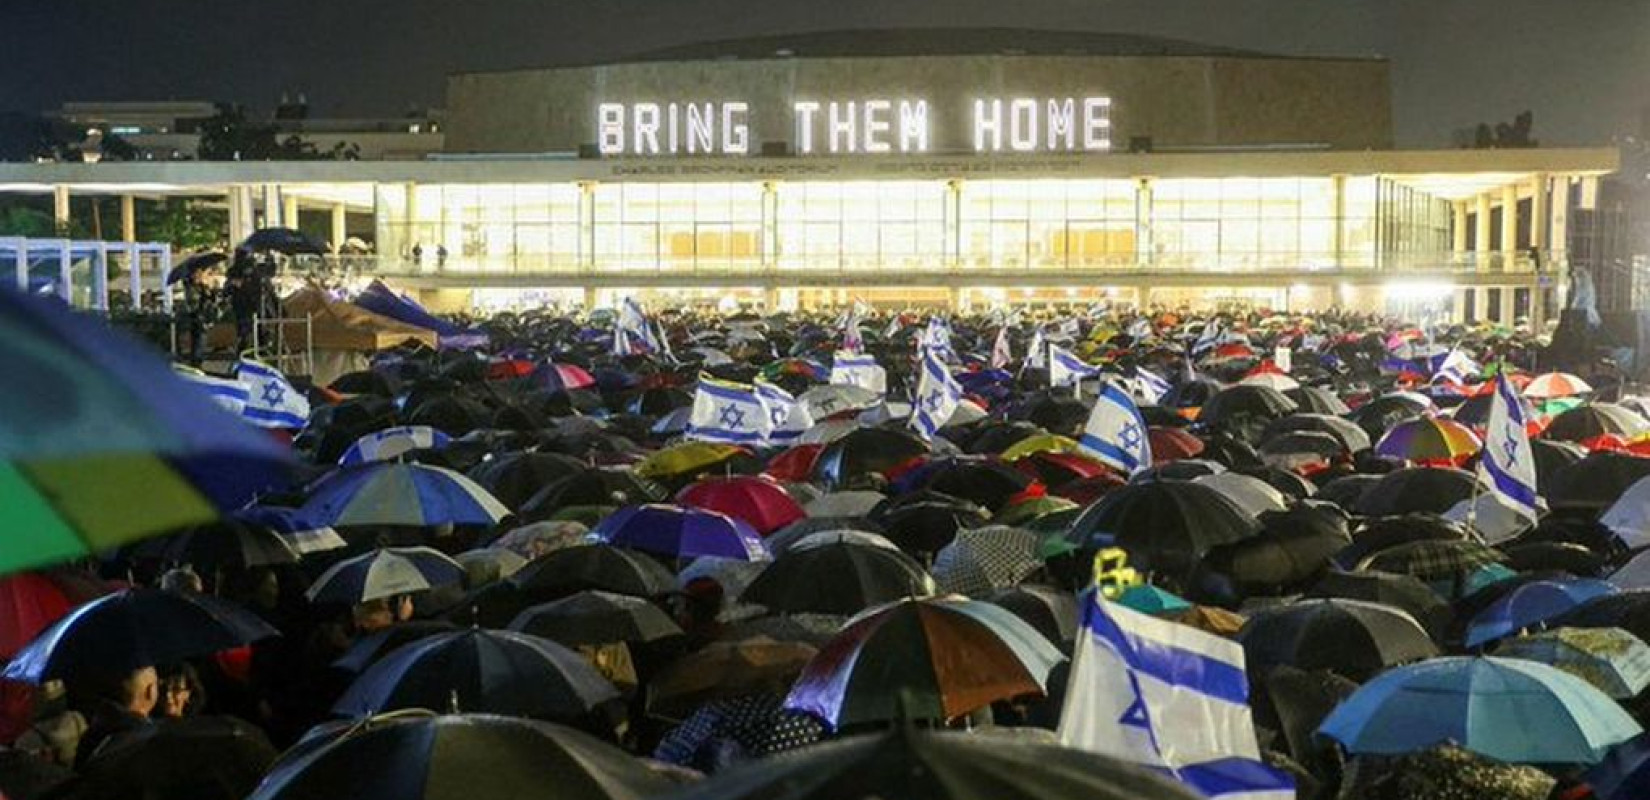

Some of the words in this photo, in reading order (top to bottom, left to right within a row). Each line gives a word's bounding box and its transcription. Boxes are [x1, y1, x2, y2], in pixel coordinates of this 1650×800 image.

[599, 102, 749, 154] BRING
[794, 100, 928, 153] THEM
[973, 97, 1112, 150] HOME
